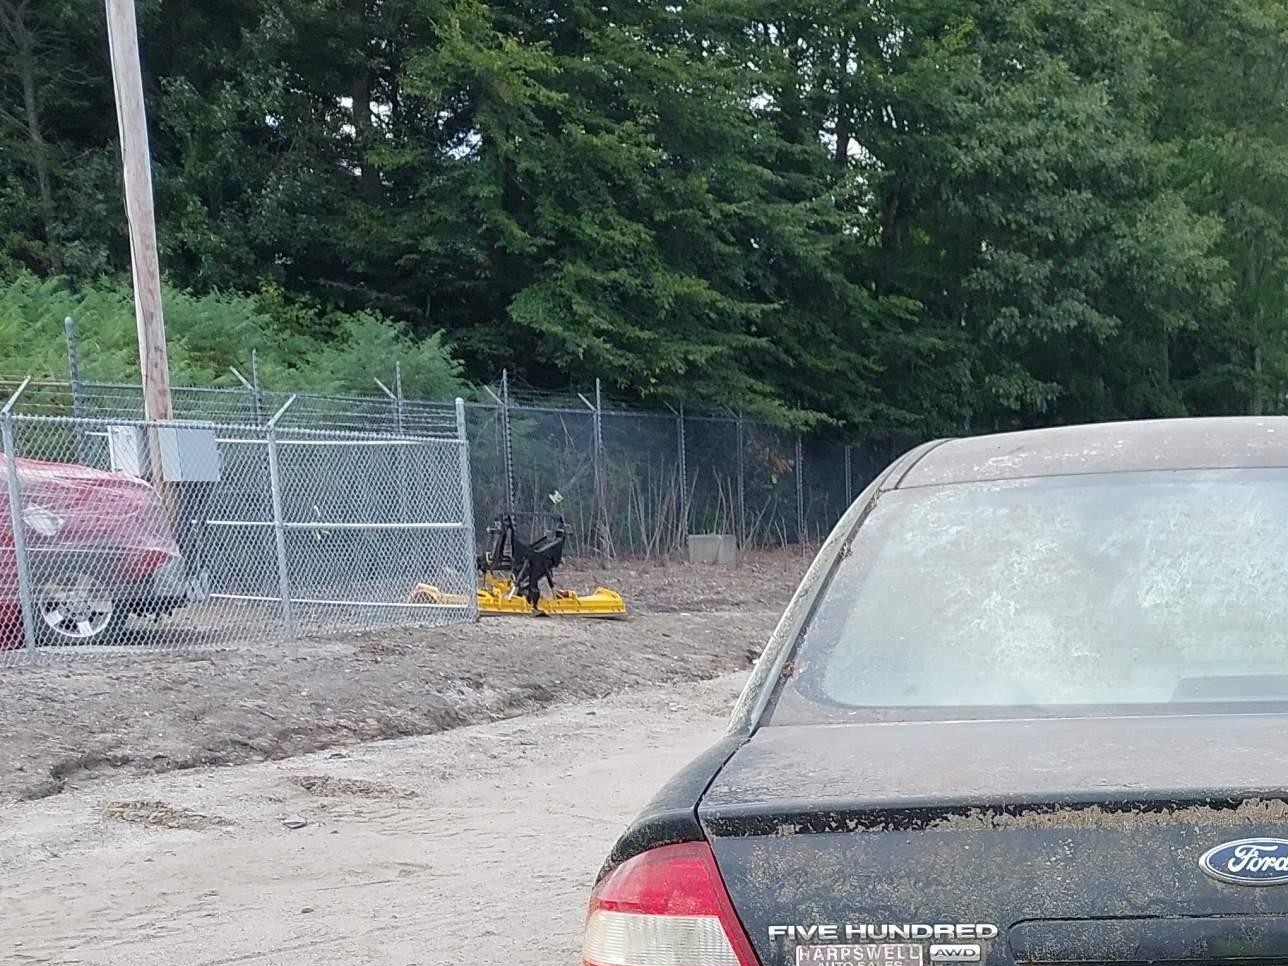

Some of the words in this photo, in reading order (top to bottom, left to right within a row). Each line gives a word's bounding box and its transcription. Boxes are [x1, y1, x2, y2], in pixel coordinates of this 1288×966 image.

[768, 925, 838, 941] FIVE
[845, 923, 998, 940] HUNDRED
[799, 946, 920, 961] HARPSWELL
[934, 948, 976, 957] AWD
